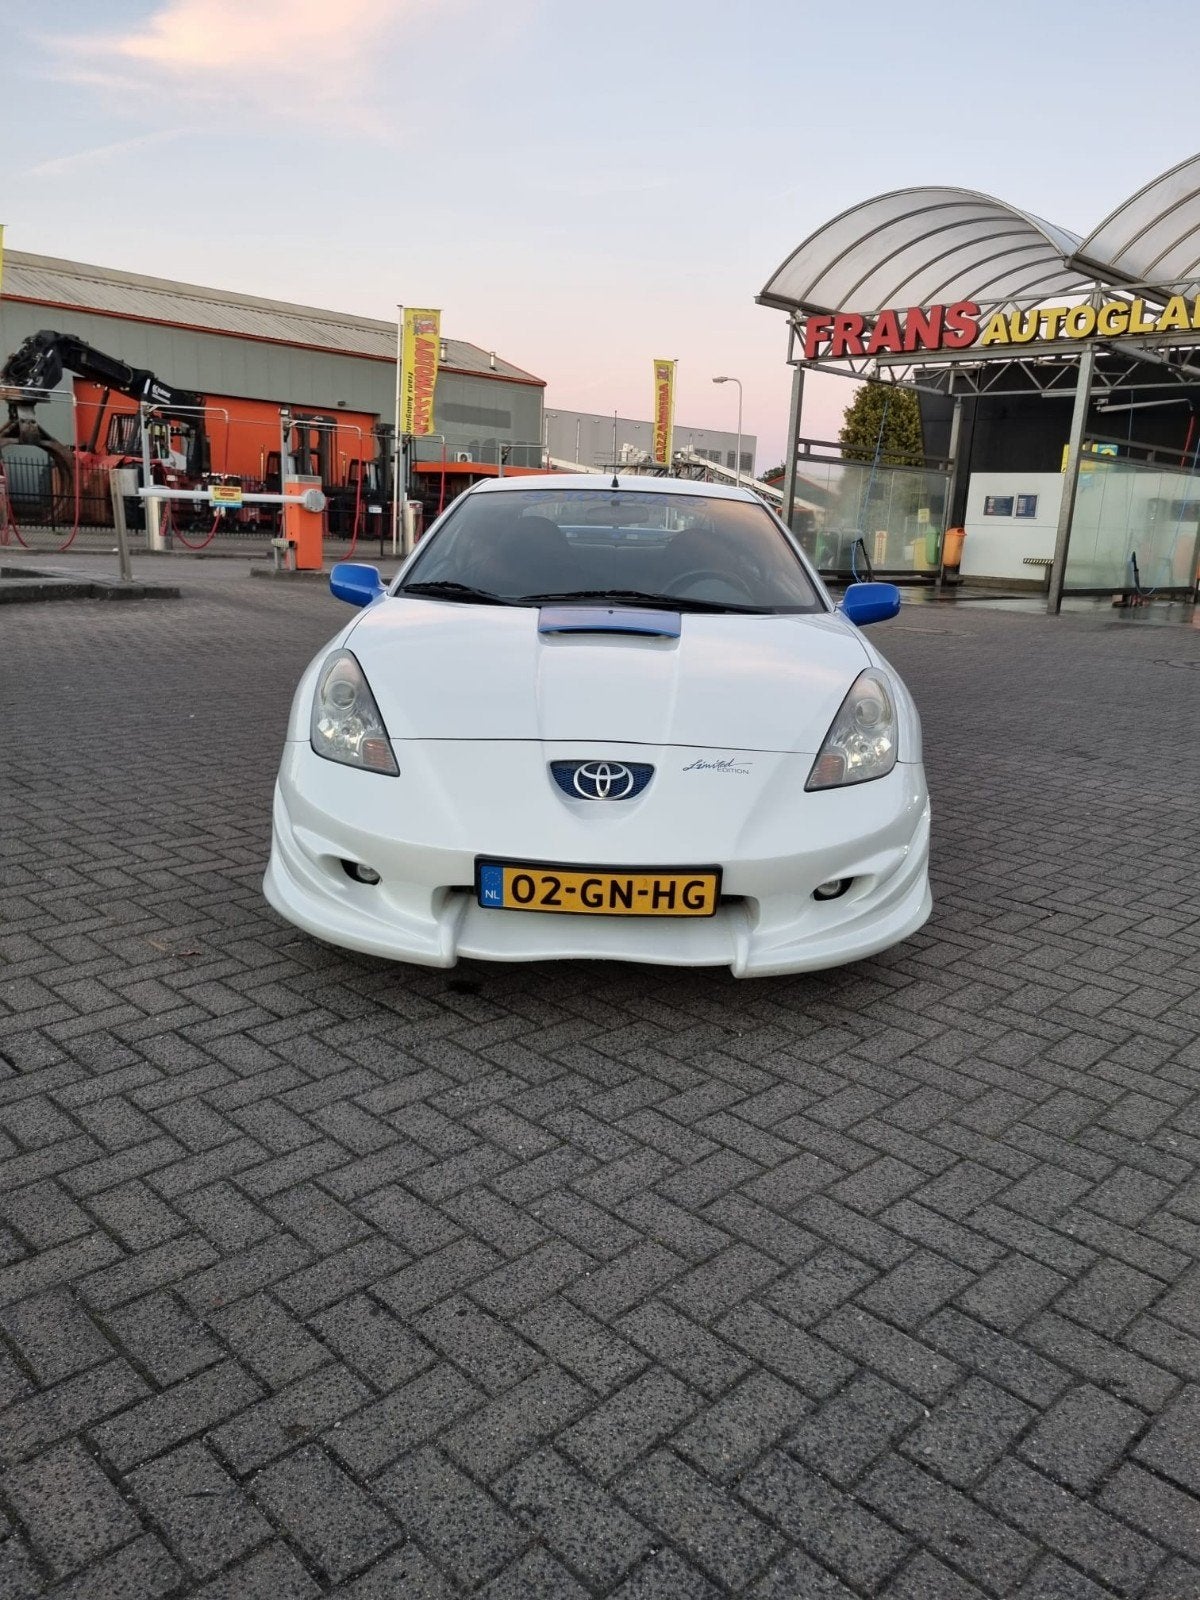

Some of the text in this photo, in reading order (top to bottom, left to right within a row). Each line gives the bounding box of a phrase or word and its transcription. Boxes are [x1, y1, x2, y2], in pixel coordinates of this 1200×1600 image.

[805, 293, 1200, 359] FRANS AUTOGLA
[565, 492, 668, 505] TOYOTA
[682, 757, 752, 772] Limited
[717, 767, 749, 775] EDITION
[485, 890, 500, 900] NL
[511, 874, 706, 910] 02-GN-HG
